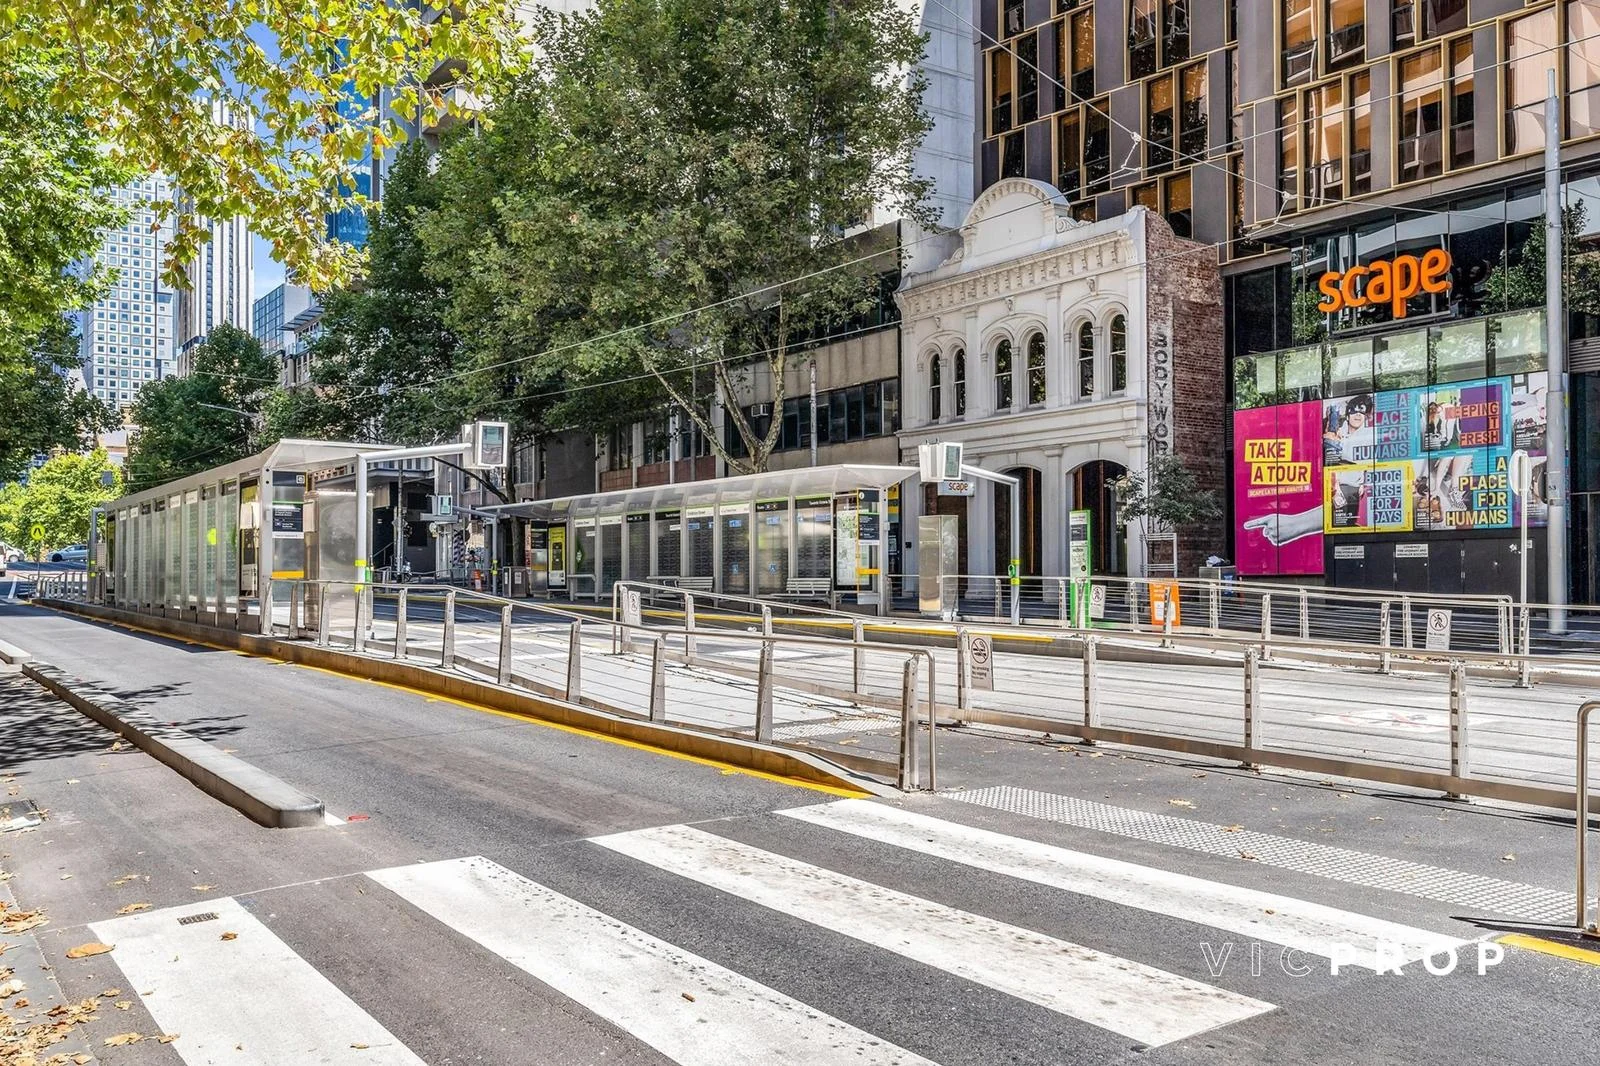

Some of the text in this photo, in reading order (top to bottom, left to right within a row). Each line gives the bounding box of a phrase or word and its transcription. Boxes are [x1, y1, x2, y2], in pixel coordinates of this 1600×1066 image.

[1318, 248, 1452, 319] scape
[1398, 393, 1408, 407] A
[1460, 430, 1499, 445] FRESH
[1248, 441, 1286, 458] TAKE
[1353, 443, 1408, 460] HUMANS
[1496, 457, 1507, 471] A
[1253, 465, 1308, 482] A TOUR
[948, 482, 969, 494] scape
[1459, 474, 1507, 491] PLACE
[1393, 497, 1401, 509] 7
[1478, 492, 1507, 507] FOR
[1446, 509, 1507, 526] HUMANS
